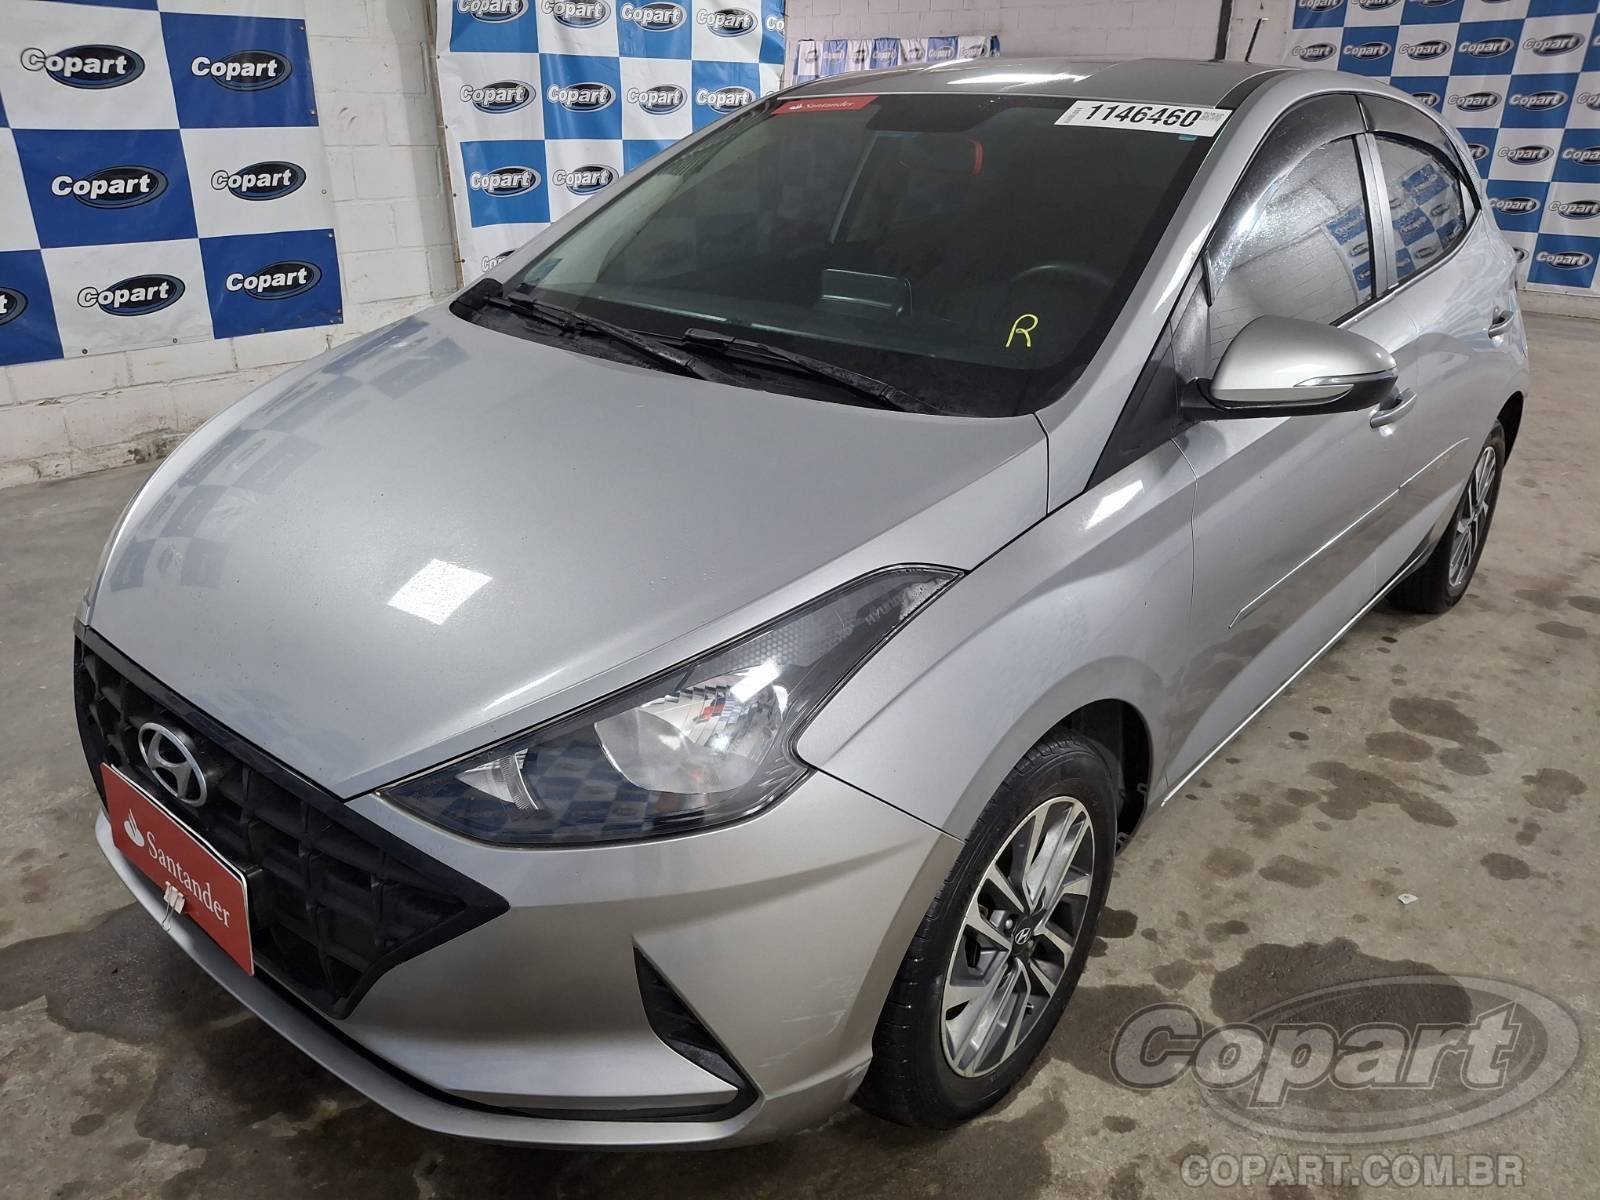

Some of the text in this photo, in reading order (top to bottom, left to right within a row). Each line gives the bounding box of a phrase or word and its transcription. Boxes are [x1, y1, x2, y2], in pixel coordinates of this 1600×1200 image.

[458, 0, 519, 15] Copart
[541, 0, 602, 20] Copart
[621, 4, 681, 25] Copart
[696, 9, 752, 31] Copart
[1292, 43, 1332, 57] Copart
[1343, 41, 1385, 57] Copart
[1399, 41, 1445, 57] Copart
[1458, 38, 1508, 55] Copart
[1522, 34, 1577, 53] Copart
[21, 47, 128, 76] Copart
[190, 56, 279, 82] Copart
[459, 84, 525, 105] Copart
[547, 84, 609, 105] Copart
[626, 88, 682, 107] Copart
[696, 89, 753, 107] Copart
[1448, 93, 1495, 108] Copart
[1509, 92, 1562, 109] Copart
[1086, 104, 1202, 128] 1146460
[1498, 146, 1546, 162] Copart
[51, 173, 152, 200] Copart
[211, 167, 293, 191] Copart
[471, 171, 531, 190] Copart
[552, 168, 611, 188] Copart
[1489, 197, 1535, 213] Copart
[1549, 200, 1600, 216] Copart
[1536, 250, 1586, 268] Copart
[226, 265, 309, 294] Copart
[78, 279, 171, 309] Copart
[1005, 313, 1039, 348] R
[146, 830, 231, 928] Santander
